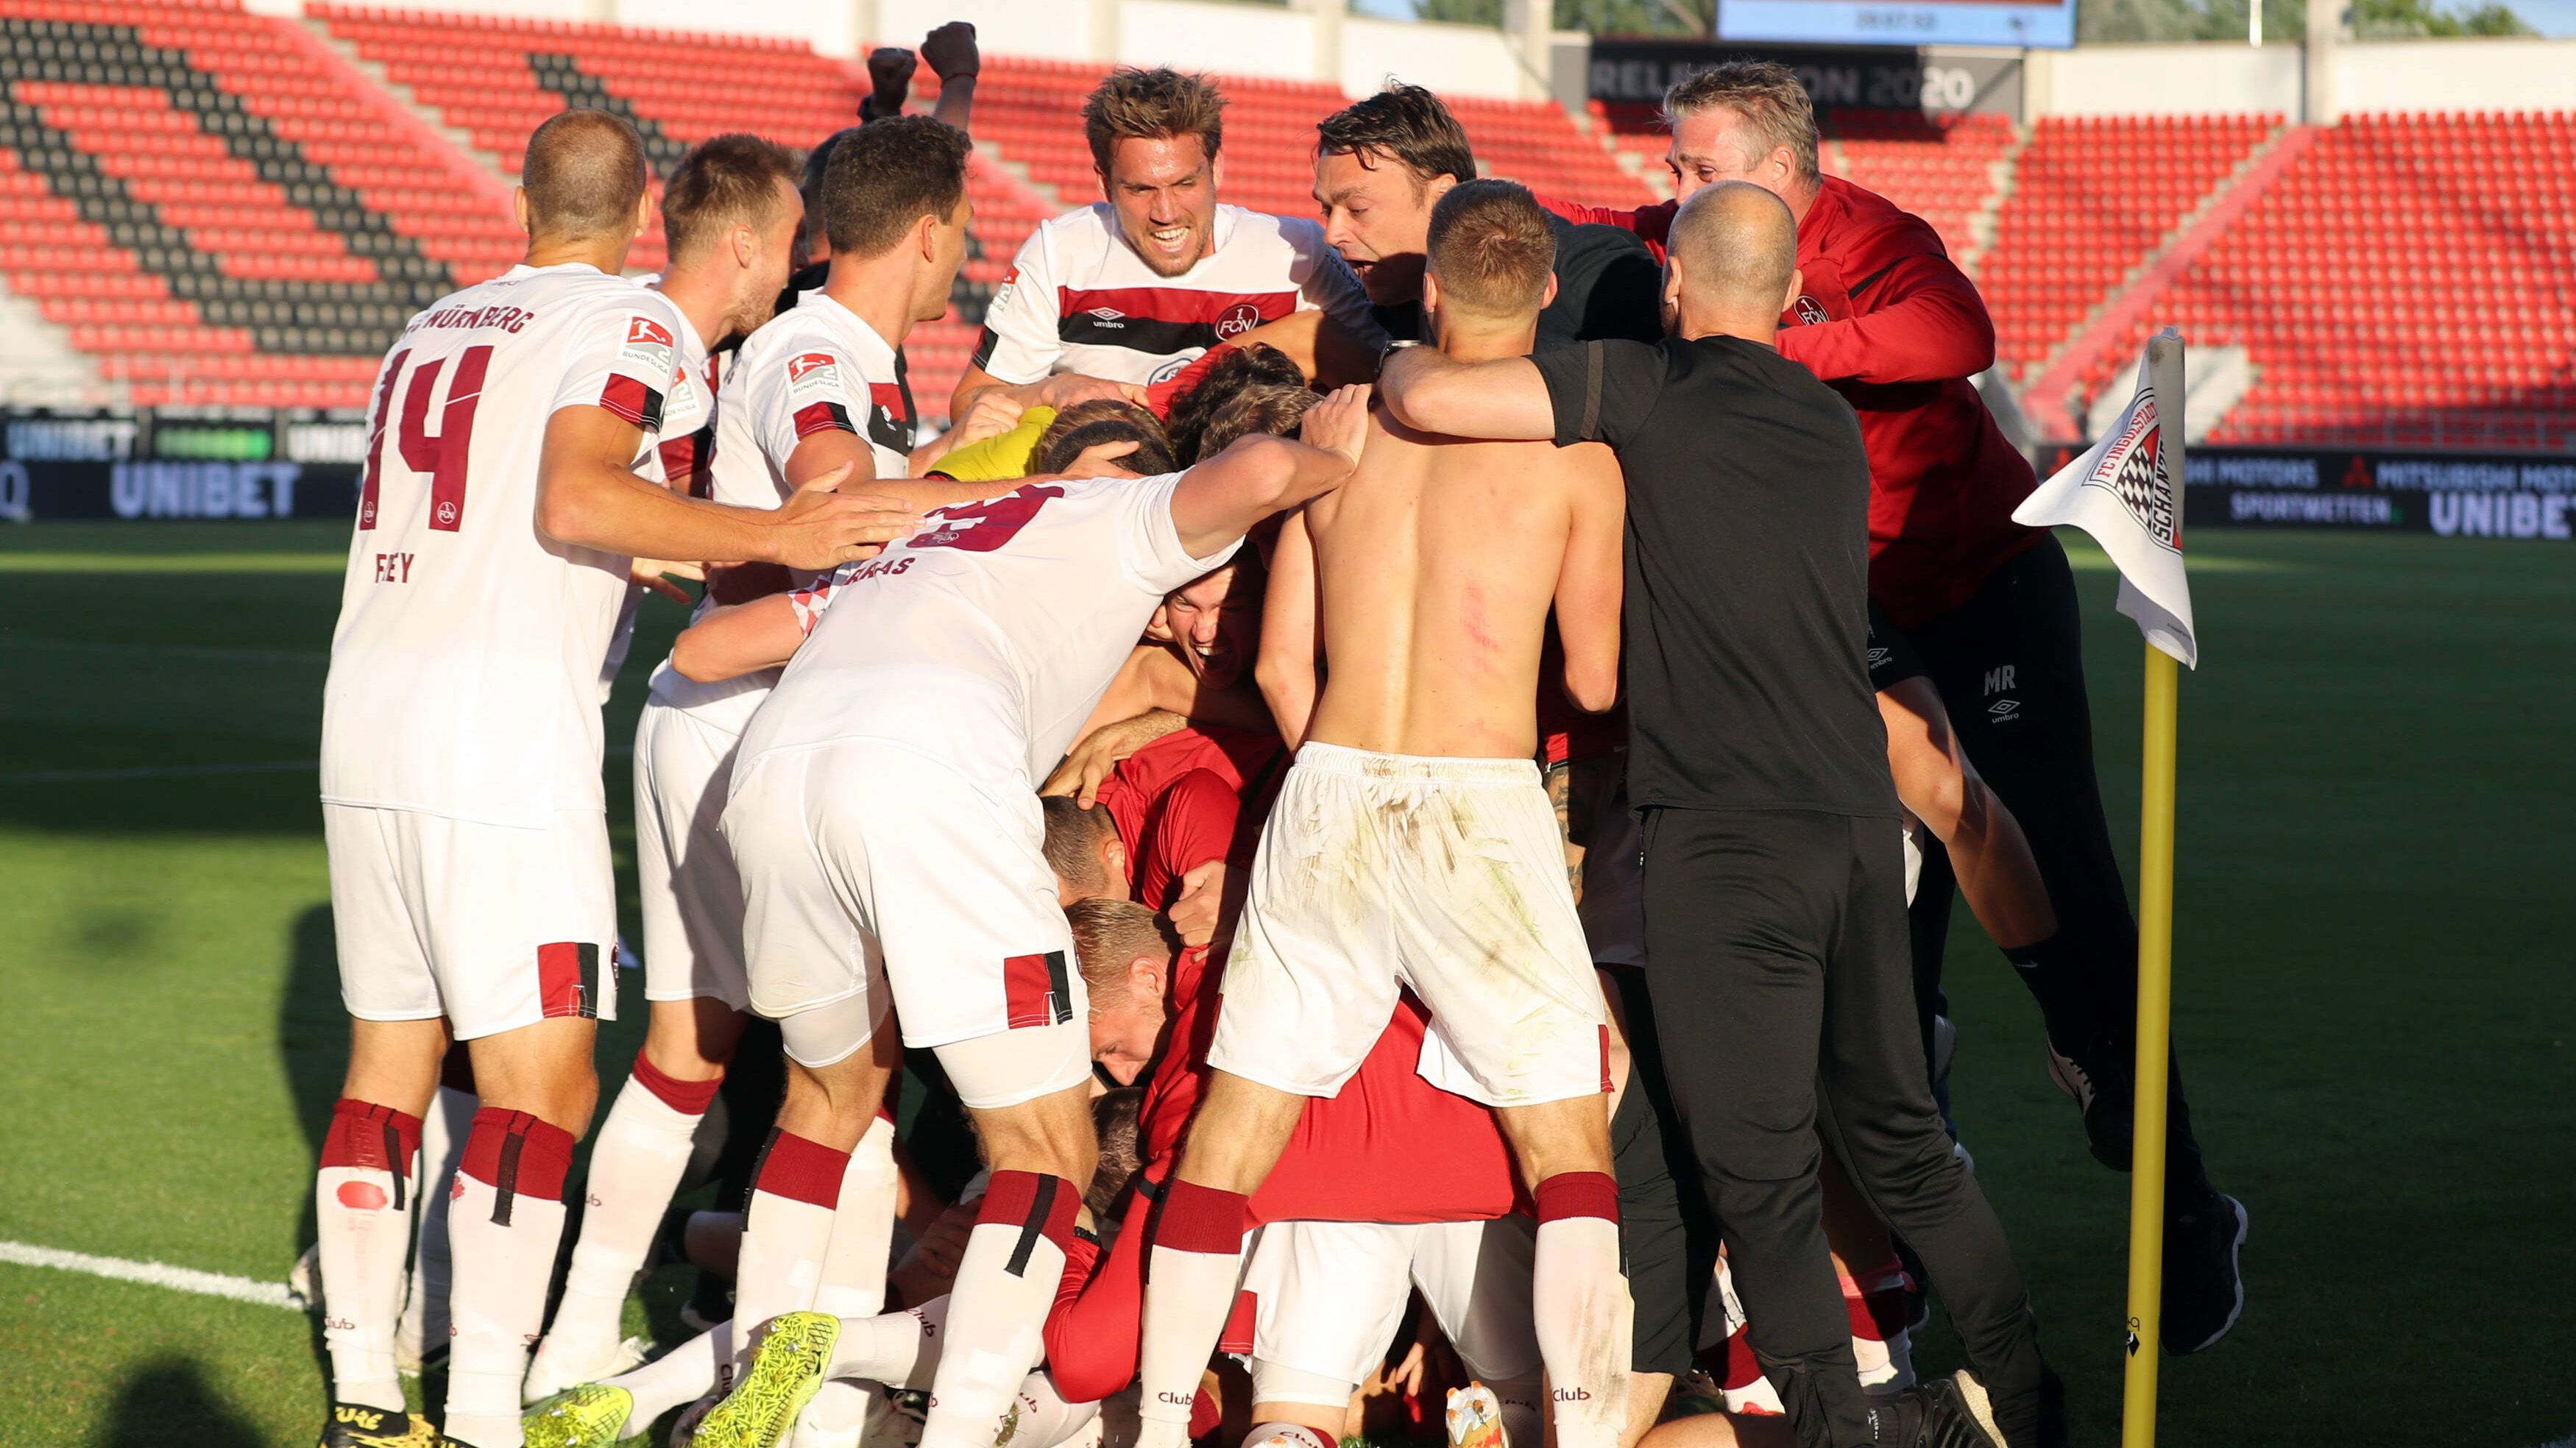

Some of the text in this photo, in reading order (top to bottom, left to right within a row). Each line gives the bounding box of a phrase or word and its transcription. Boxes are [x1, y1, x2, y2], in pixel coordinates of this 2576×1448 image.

[1868, 67, 1977, 110] 2020
[422, 304, 534, 333] NÜRNBERG
[1093, 321, 1125, 329] umbro
[1220, 318, 1253, 335] FCN
[1801, 310, 1827, 326] FCN
[623, 350, 668, 375] BUNDESLIGA
[793, 380, 840, 394] BUNDESLIGA
[358, 346, 494, 533] 14
[2098, 462, 2115, 478] FC
[2376, 461, 2517, 491] MITSUBISHI
[111, 462, 301, 519] UNIBET
[2430, 491, 2576, 539] UNIBE
[1984, 664, 2016, 696] MR
[1992, 713, 2019, 723] umbro
[1158, 1391, 1193, 1406] Club
[1552, 1387, 1591, 1402] Club
